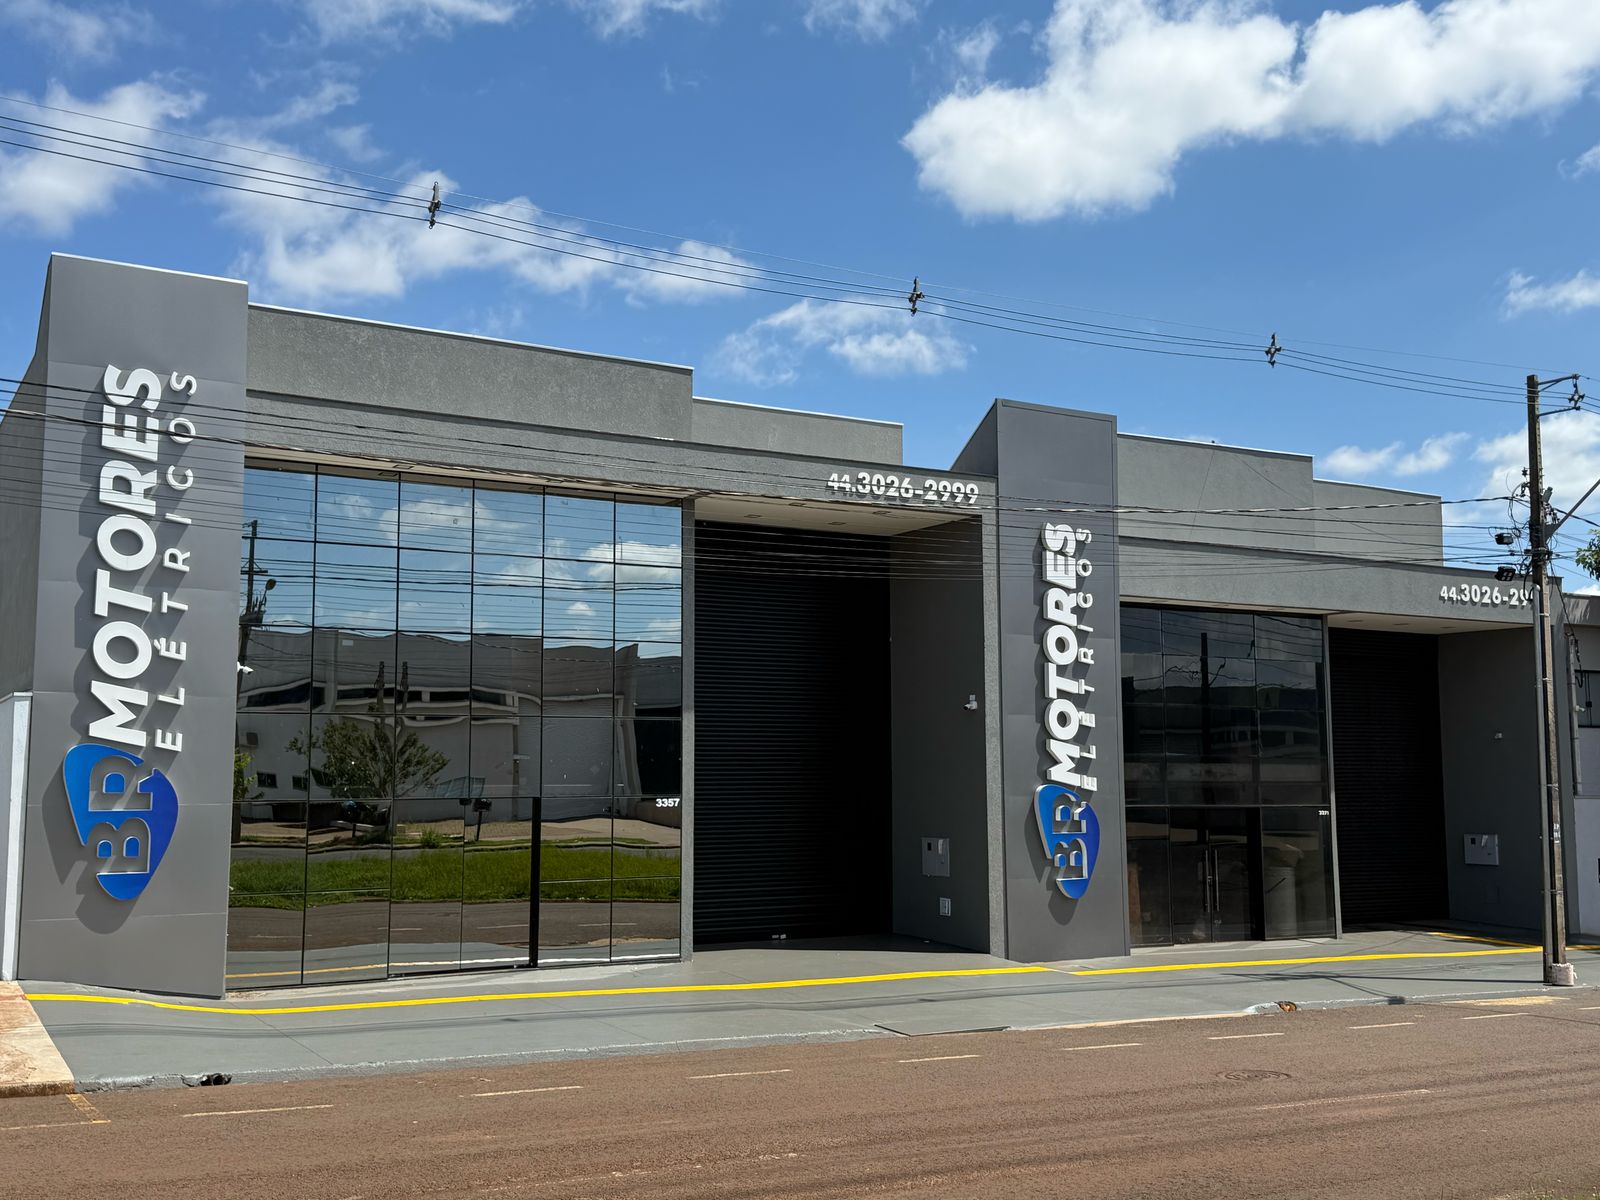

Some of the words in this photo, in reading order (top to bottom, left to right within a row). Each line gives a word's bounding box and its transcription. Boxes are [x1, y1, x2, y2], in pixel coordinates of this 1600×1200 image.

[89, 364, 162, 747] MOTORES
[154, 371, 197, 752] ELÉTRICOS
[827, 472, 979, 504] 44.3026-2999
[1041, 522, 1079, 786] MOTORES
[1075, 528, 1098, 792] ELÉTRICOS
[1440, 583, 1533, 606] 44.3026-29
[87, 755, 154, 874] BR
[655, 798, 680, 807] 3357
